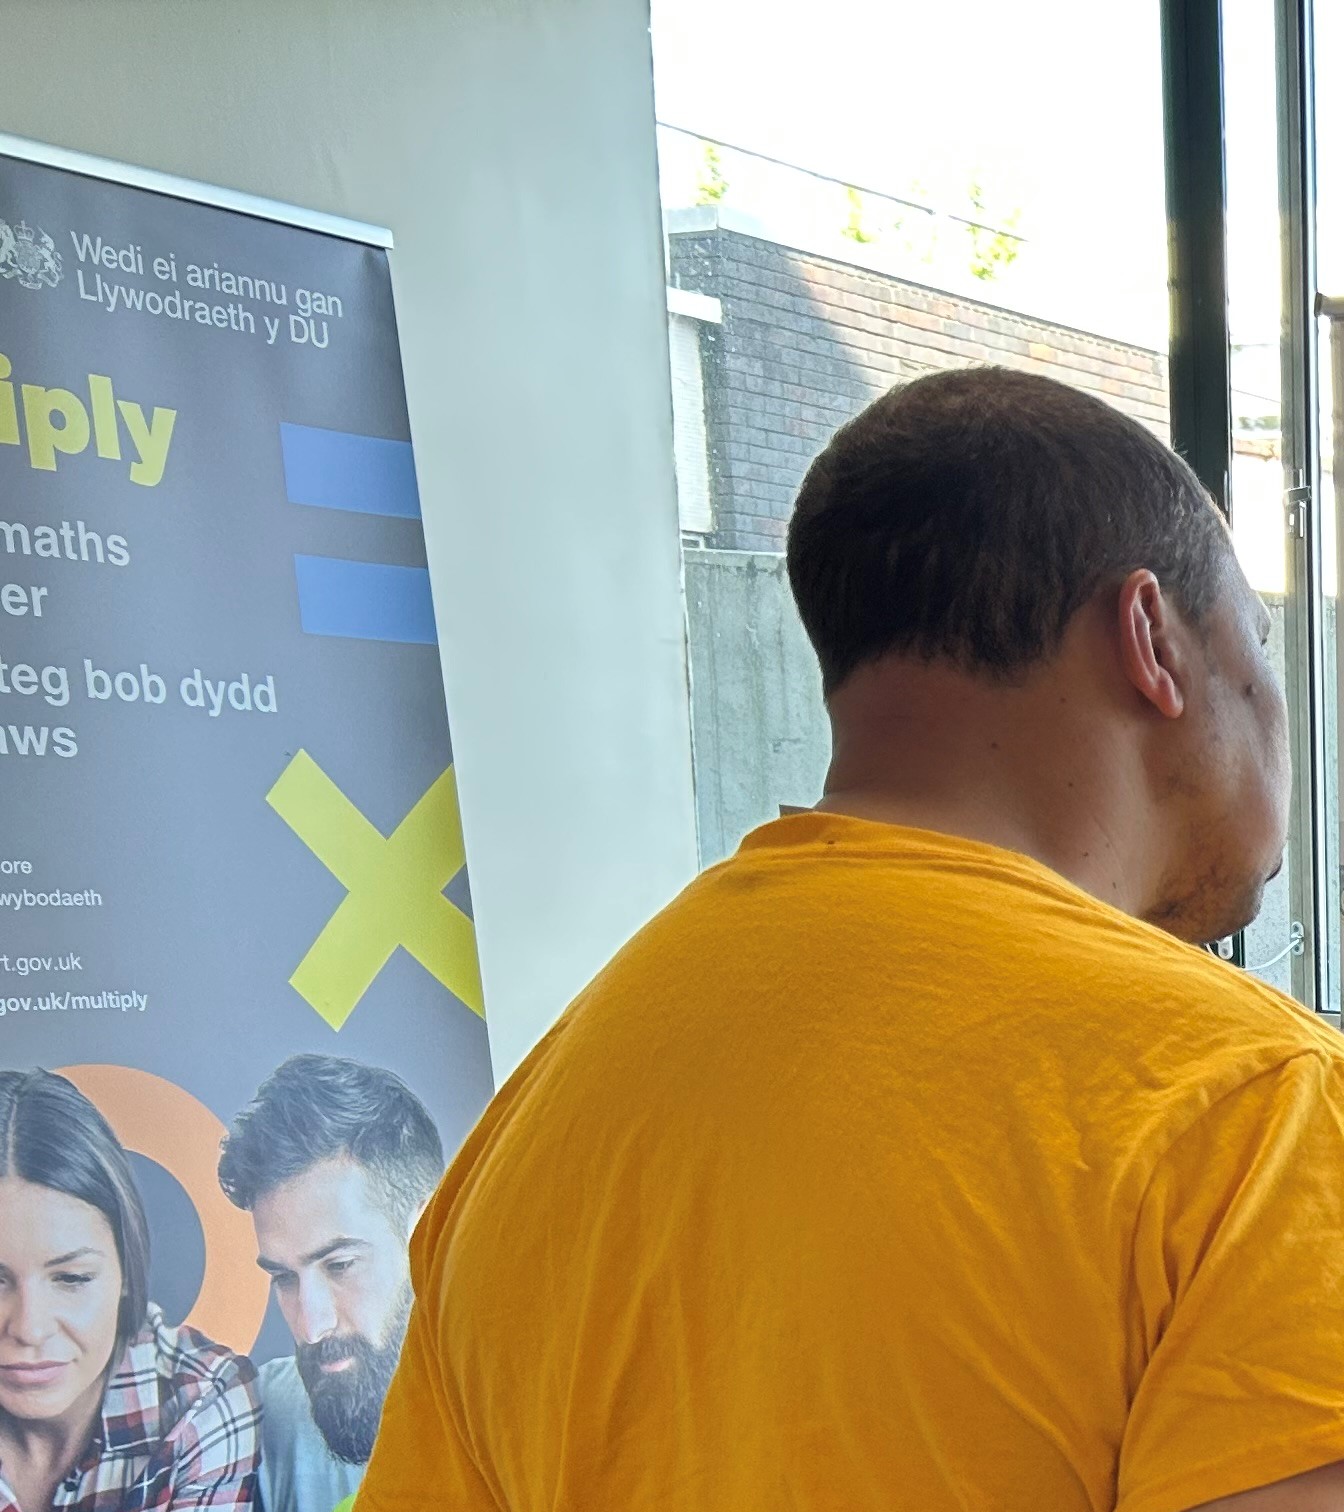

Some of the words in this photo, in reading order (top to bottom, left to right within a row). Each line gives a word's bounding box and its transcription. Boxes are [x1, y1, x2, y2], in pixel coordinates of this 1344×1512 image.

[70, 230, 144, 275] Wedi
[153, 253, 177, 282] ei
[186, 263, 286, 305] ariannu
[296, 288, 343, 317] gan
[77, 270, 255, 334] Llywodraeth
[263, 316, 278, 344] y
[289, 315, 328, 348] DU
[0, 521, 129, 566] maths
[84, 659, 166, 704] bob
[180, 668, 277, 717] dydd
